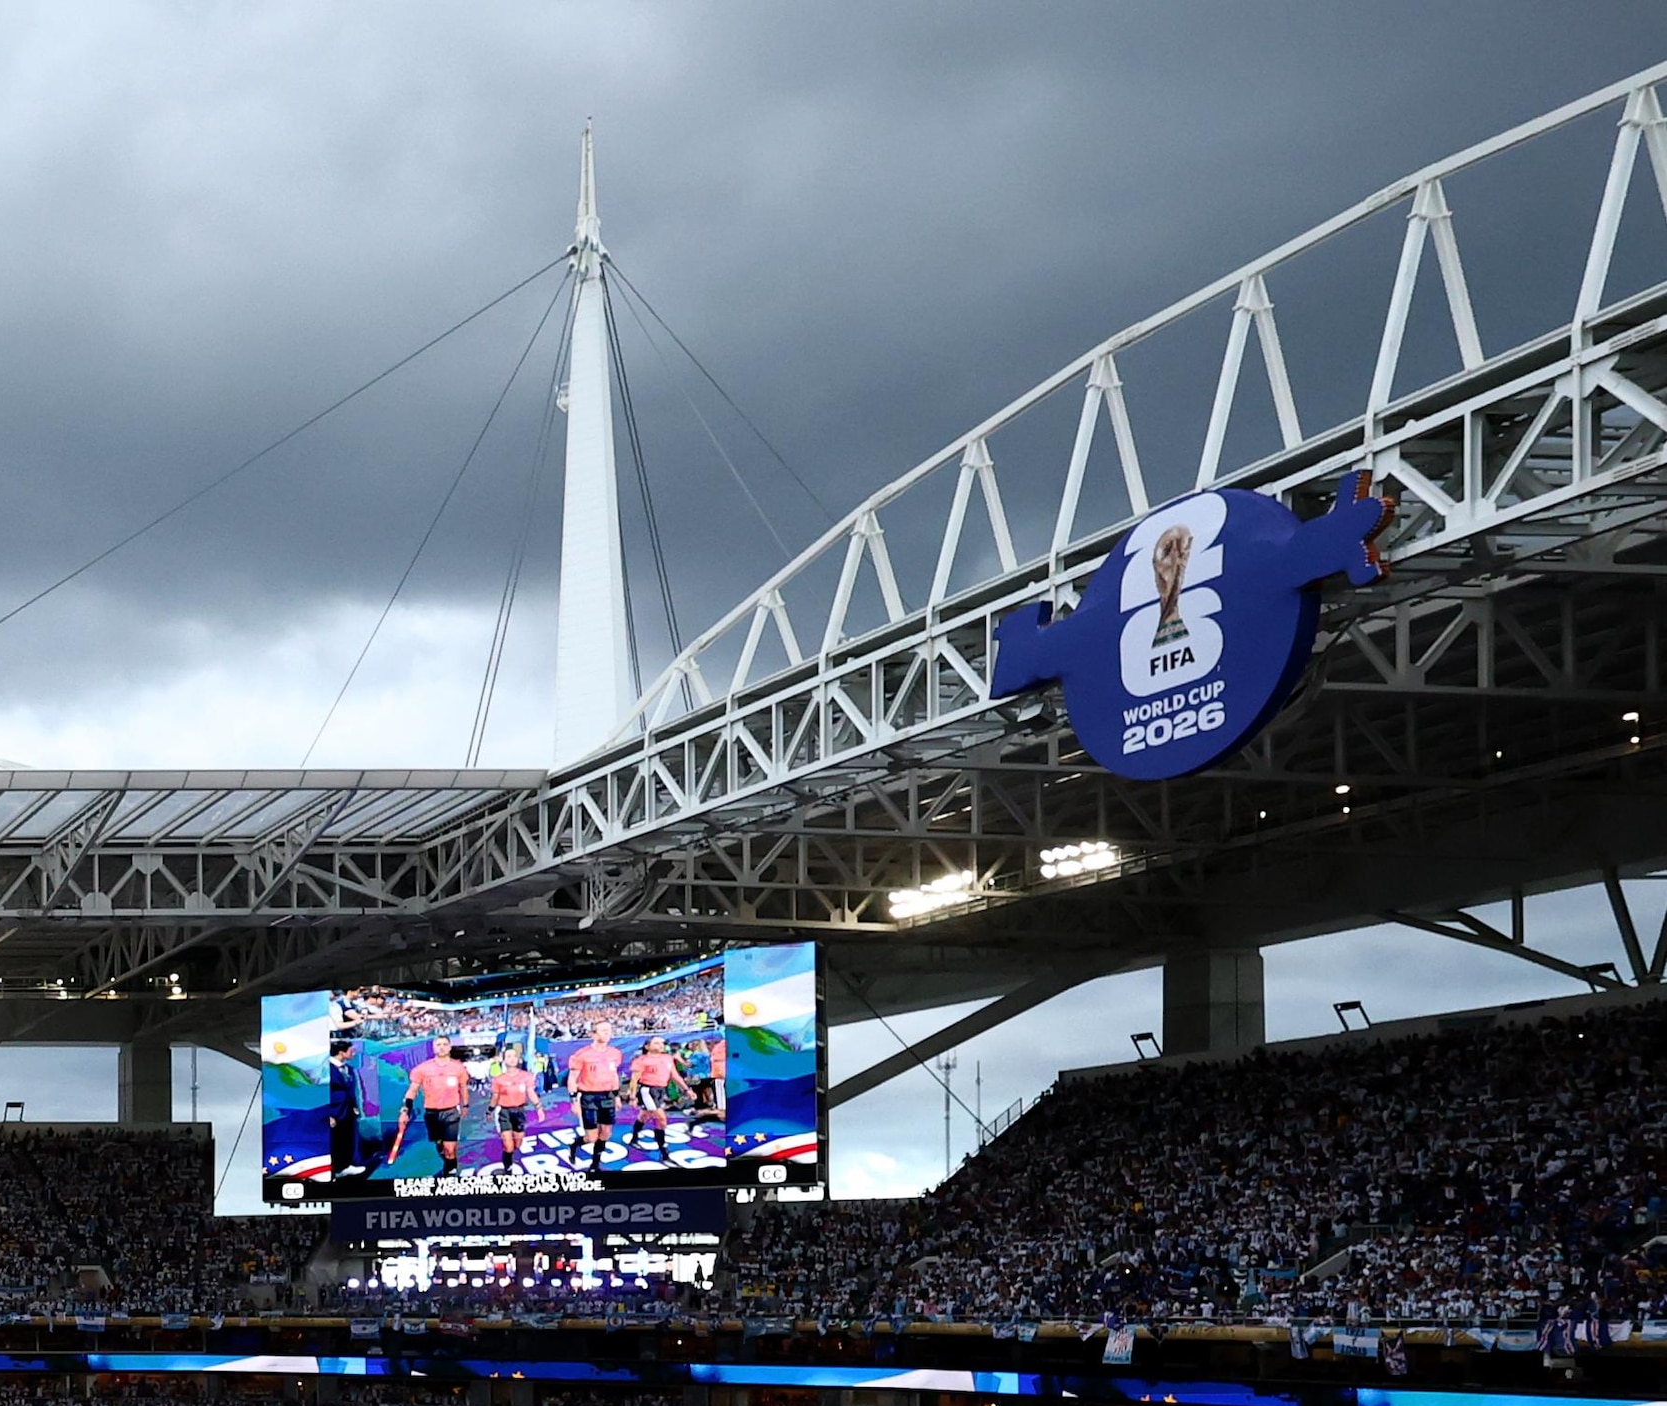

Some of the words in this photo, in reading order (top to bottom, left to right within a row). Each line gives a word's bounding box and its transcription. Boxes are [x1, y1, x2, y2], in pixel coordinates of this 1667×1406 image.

[1149, 646, 1195, 677] FIFA
[1122, 692, 1185, 726] WORLD
[1187, 679, 1226, 707] CUP
[1122, 701, 1226, 755] 2026
[394, 1177, 435, 1189] PLEASE
[437, 1175, 494, 1188] WELCOME
[558, 1172, 586, 1183] TWO
[435, 1184, 500, 1196] ARGENTINA
[500, 1183, 524, 1194] AND
[525, 1181, 559, 1193] CABO
[365, 1210, 419, 1230] FIFA
[422, 1207, 516, 1229] WORLD
[521, 1206, 576, 1225] CUP
[580, 1202, 680, 1225] 2026
